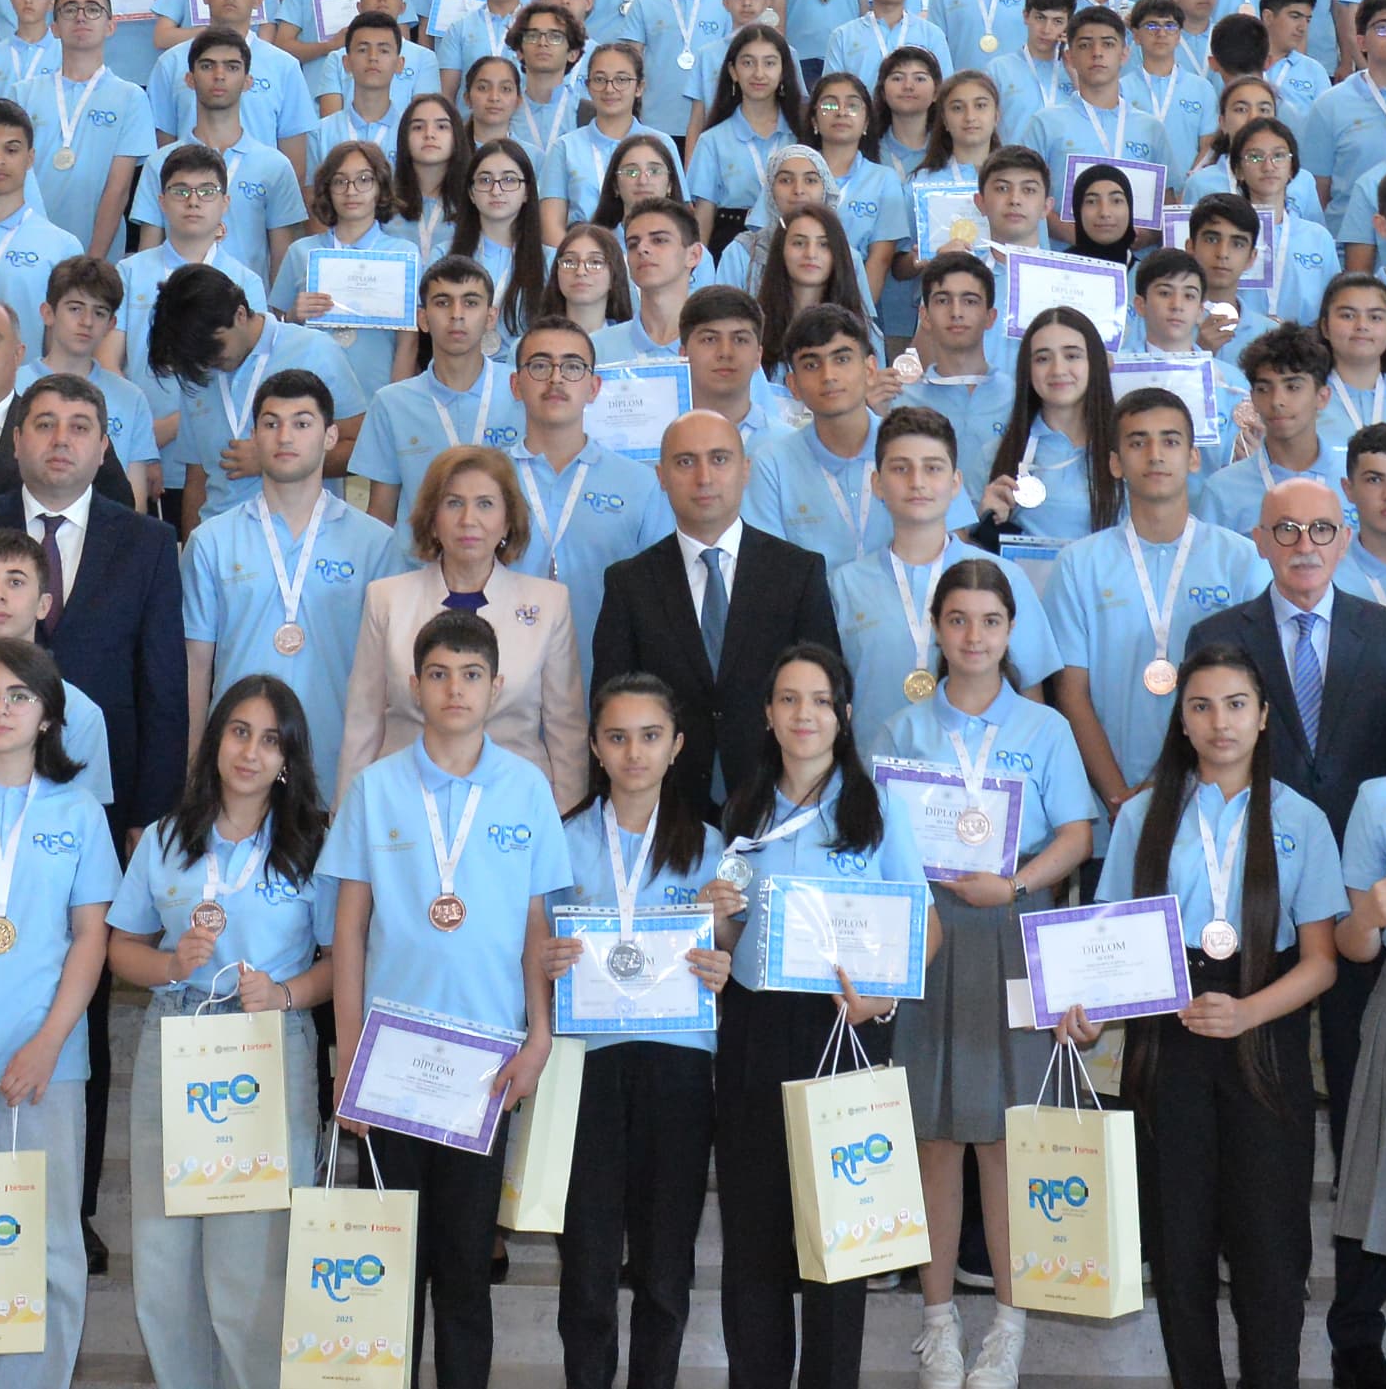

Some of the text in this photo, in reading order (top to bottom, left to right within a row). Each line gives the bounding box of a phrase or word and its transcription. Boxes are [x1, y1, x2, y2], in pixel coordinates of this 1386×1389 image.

[249, 78, 270, 92] FO
[87, 110, 117, 127] RFO
[1125, 141, 1150, 157] RFO
[238, 180, 267, 199] RFO
[849, 201, 878, 219] RFO
[5, 251, 39, 267] RFO
[1293, 253, 1323, 270] RFO
[608, 399, 643, 409] DİPLOM
[484, 426, 517, 448] RFO
[583, 492, 624, 514] RFO
[315, 559, 354, 583] RFO
[1189, 586, 1230, 612] RFO
[996, 751, 1033, 773] RFO
[34, 831, 74, 856] RFO
[488, 824, 531, 853] RFO
[827, 850, 867, 876] RFO
[256, 880, 298, 906] RFO
[664, 886, 698, 904] RFO
[1082, 940, 1127, 956] DİPLOM
[412, 1057, 455, 1077] DİPLOM
[187, 1074, 260, 1123] RFO
[831, 1133, 893, 1186] RFO
[1029, 1176, 1089, 1223] RFO
[311, 1254, 385, 1303] RFO
